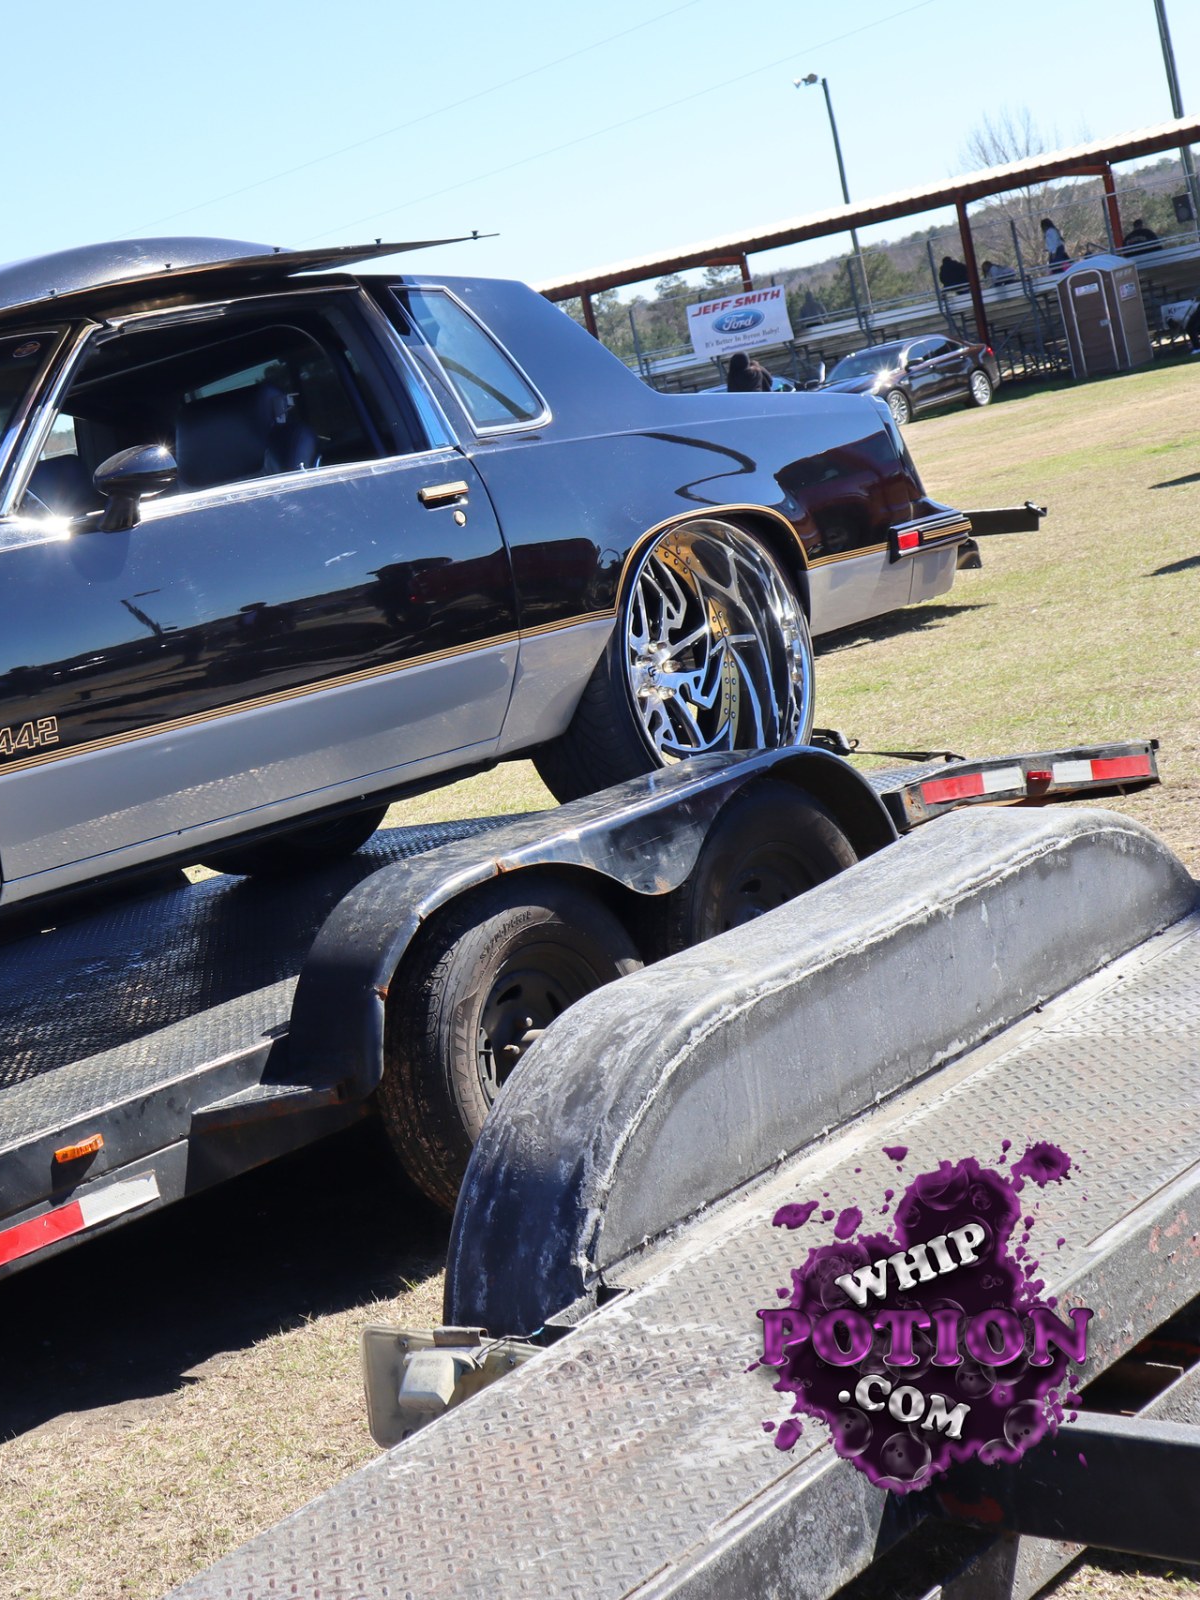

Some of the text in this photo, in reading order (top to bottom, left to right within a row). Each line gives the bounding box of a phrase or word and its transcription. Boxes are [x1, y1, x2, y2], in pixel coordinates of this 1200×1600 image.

[692, 289, 780, 317] JEFF SMITH
[722, 313, 754, 331] Ford
[715, 336, 734, 346] Better
